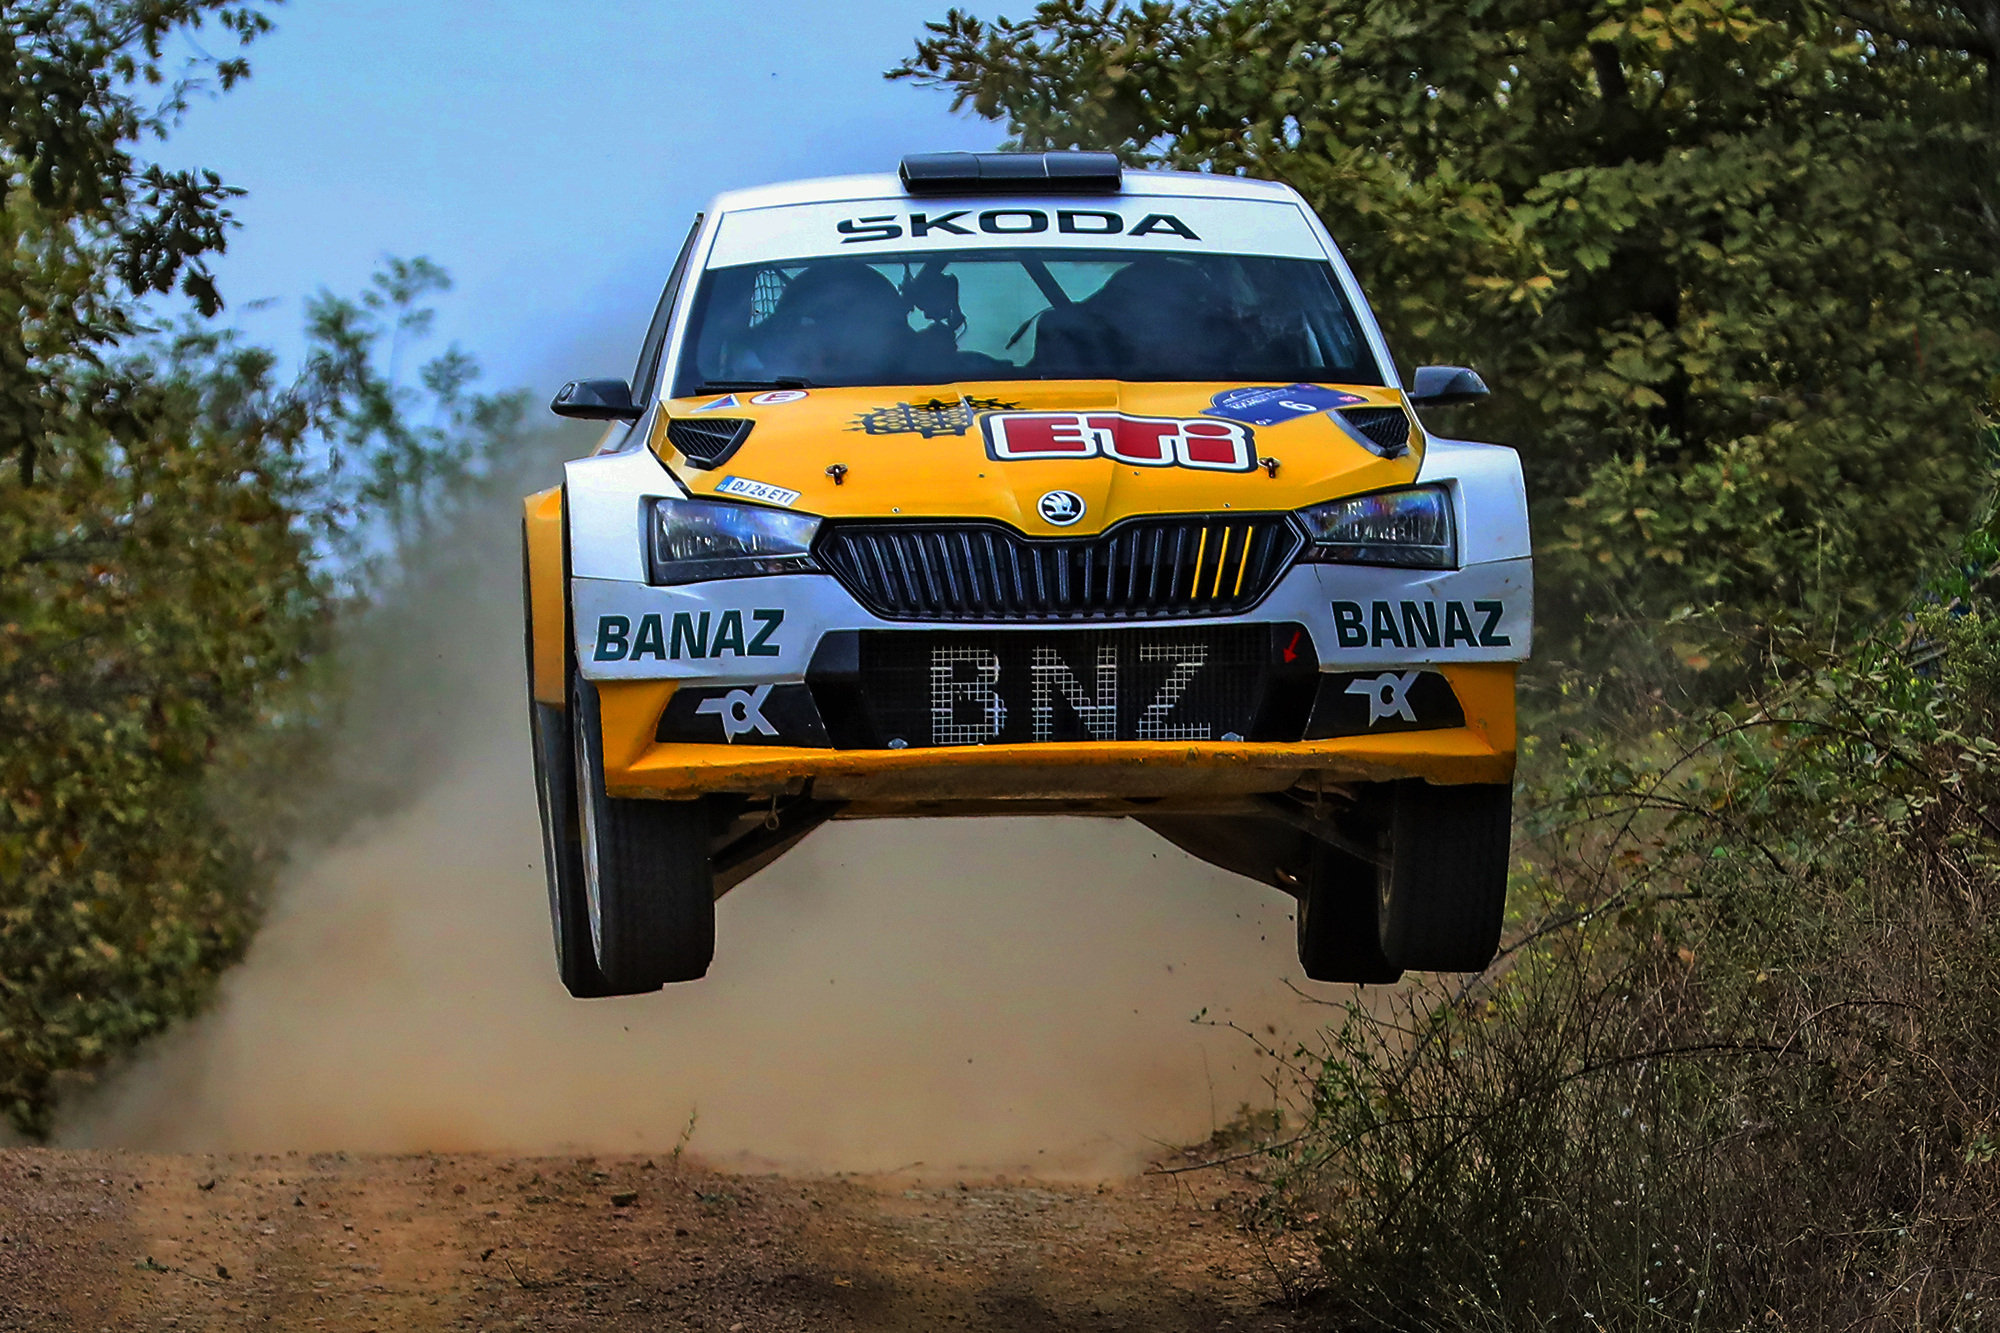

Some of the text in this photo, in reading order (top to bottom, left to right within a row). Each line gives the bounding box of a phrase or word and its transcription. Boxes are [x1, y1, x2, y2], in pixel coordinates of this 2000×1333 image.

[762, 391, 796, 402] E
[1278, 400, 1318, 412] 6
[731, 480, 752, 493] DJ
[749, 484, 769, 497] 26
[767, 488, 794, 503] ETI
[592, 608, 785, 662] BANAZ
[1330, 599, 1512, 648] BANAZ
[930, 644, 1212, 745] BNZ
